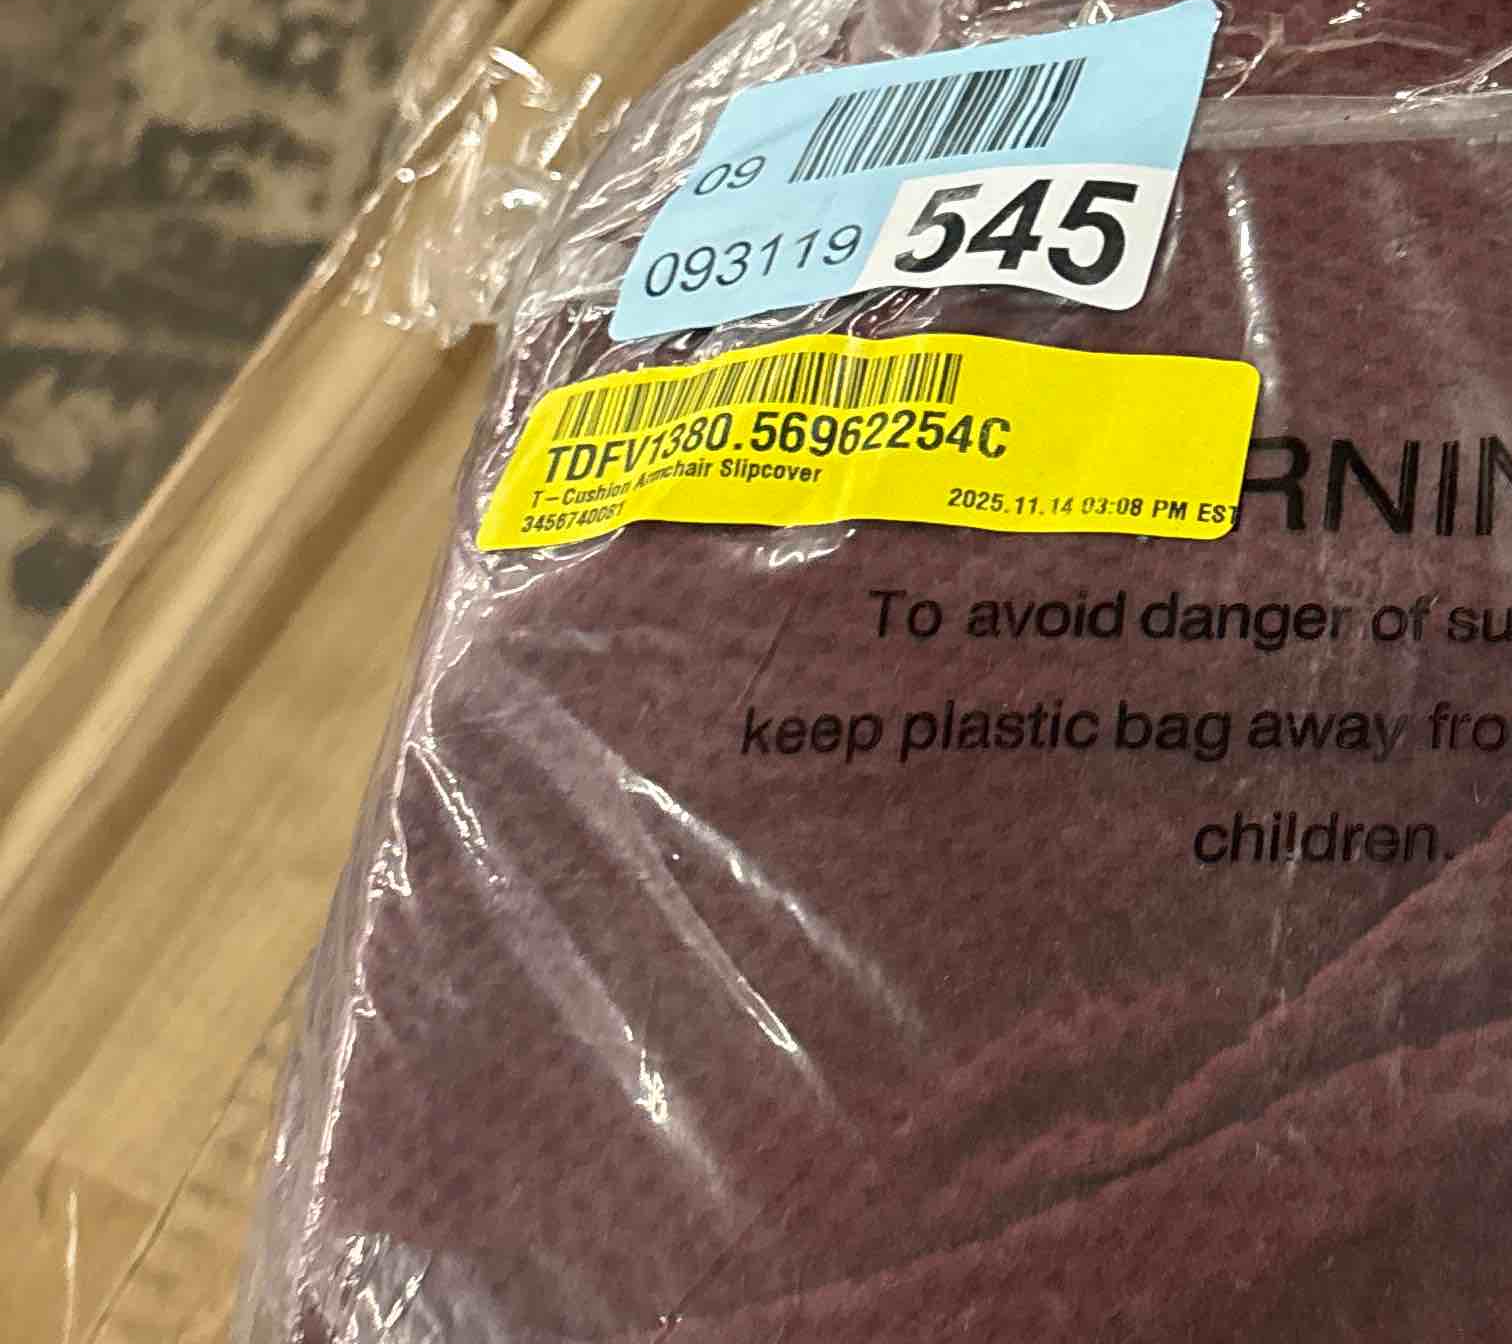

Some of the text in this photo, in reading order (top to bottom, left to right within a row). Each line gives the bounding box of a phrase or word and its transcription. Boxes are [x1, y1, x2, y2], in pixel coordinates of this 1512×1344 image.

[694, 154, 768, 197] 09
[644, 223, 863, 298] 093119
[893, 178, 1139, 287] 545
[544, 409, 1012, 484] TDFV1380.56962254C
[719, 458, 823, 483] Slipcover
[947, 487, 1240, 525] 2025.11.14 03:08 PM EST
[870, 588, 943, 639] To
[967, 590, 1128, 640] avoid
[1140, 591, 1346, 652] danger
[1371, 598, 1431, 643] of
[740, 707, 884, 764] keep
[900, 698, 1099, 762] plastic
[1114, 700, 1232, 762] bag
[1246, 708, 1402, 762] away
[1193, 811, 1456, 865] children.
